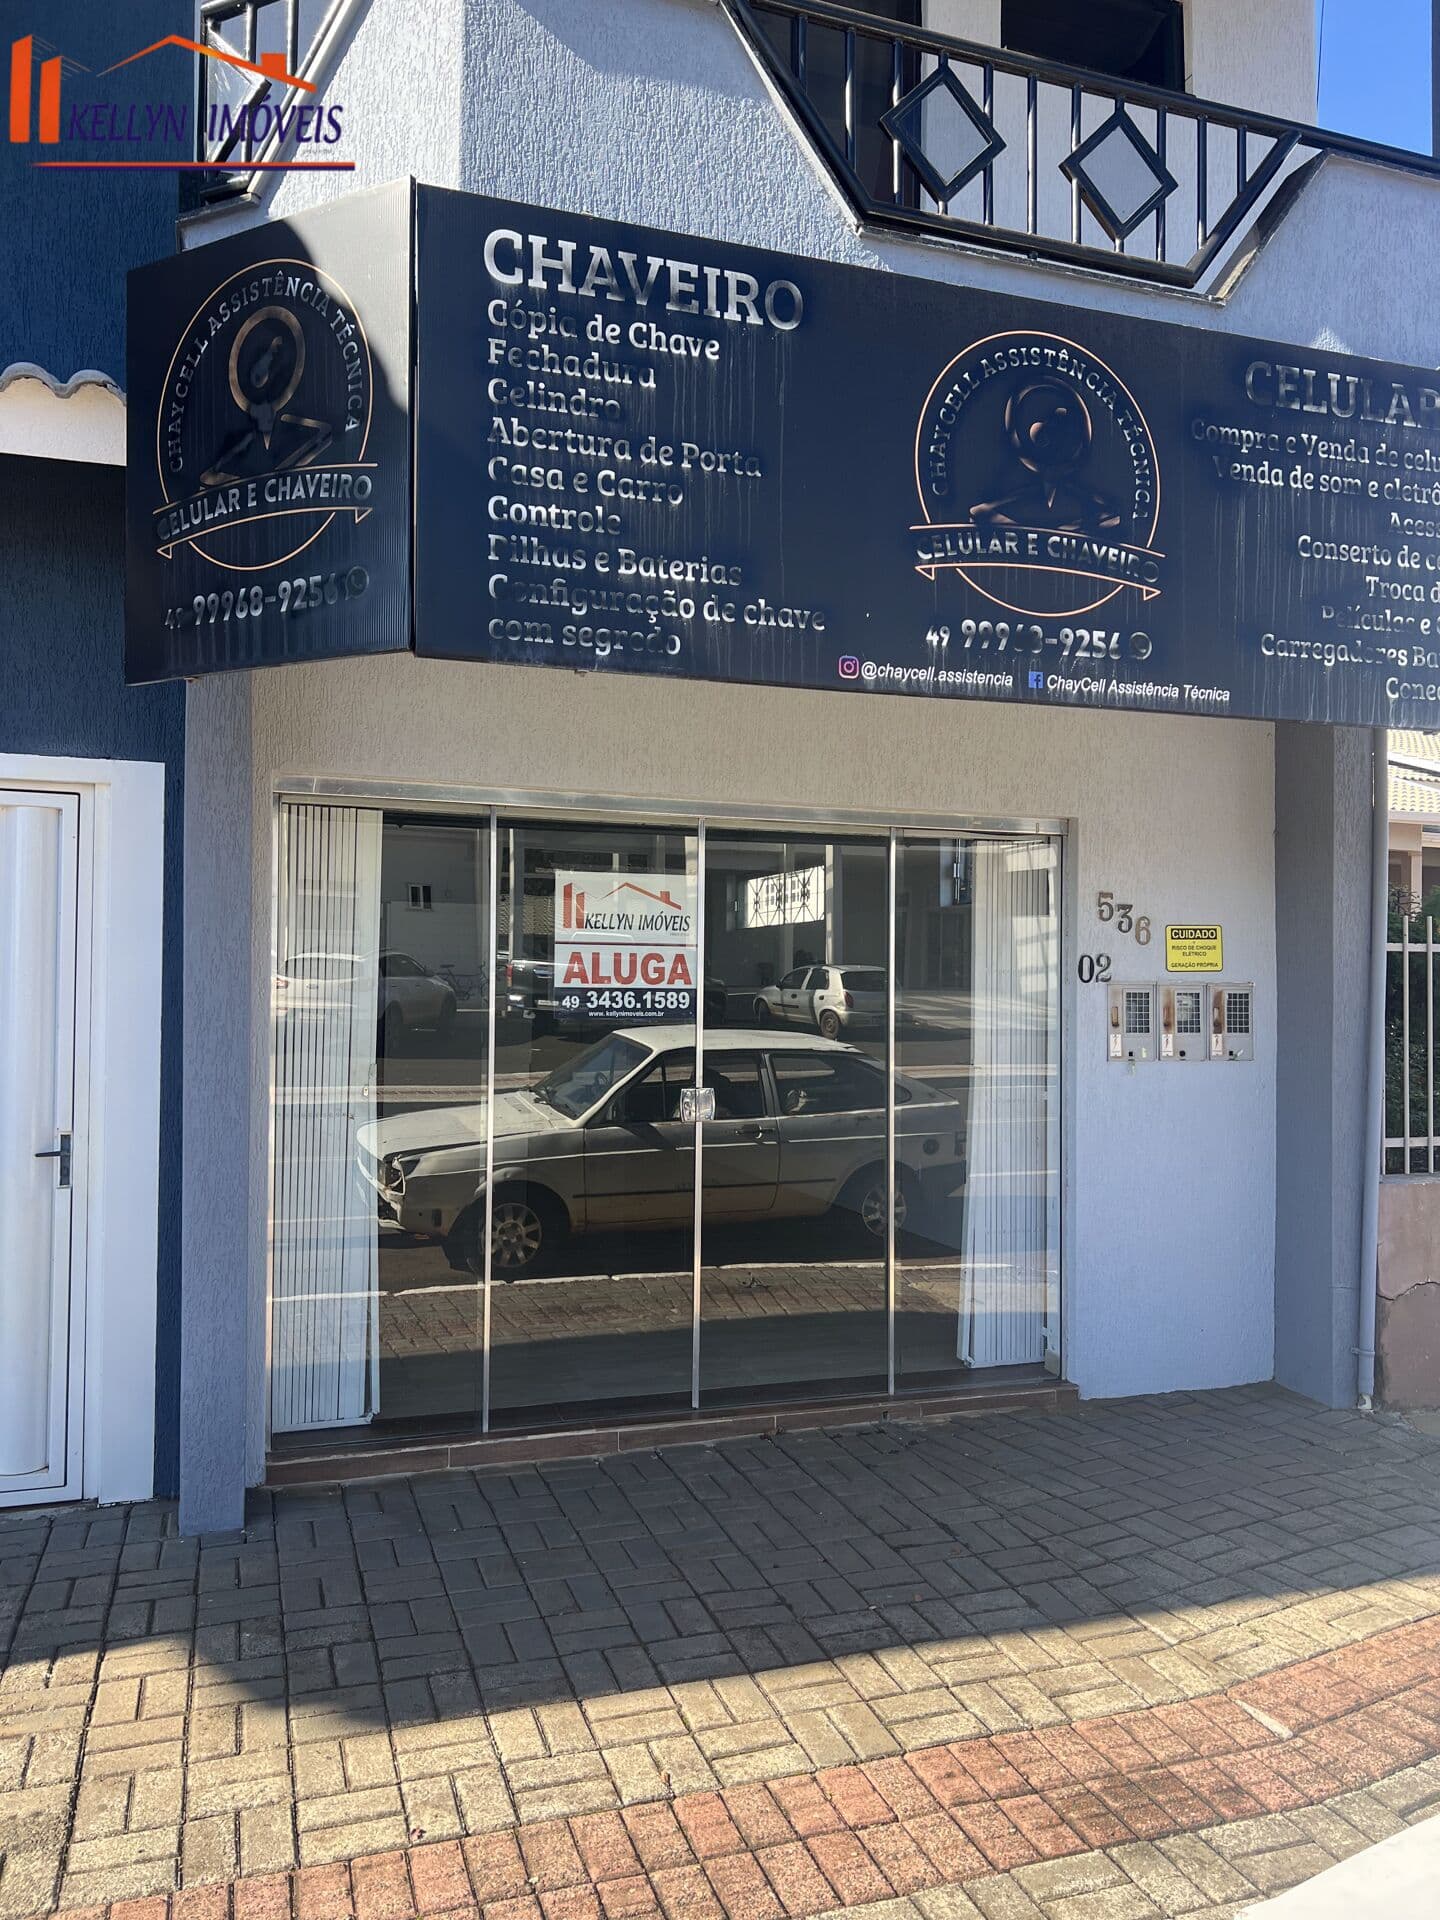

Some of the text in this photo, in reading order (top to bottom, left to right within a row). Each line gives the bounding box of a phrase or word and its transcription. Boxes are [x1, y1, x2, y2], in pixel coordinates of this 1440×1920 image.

[483, 228, 804, 331] CHAVEIRO
[487, 299, 720, 360] Cópia de Chave
[168, 270, 363, 474] CHAYCELL ASSISTÊNCIA TÉCNICA
[487, 337, 657, 388] Fechadura
[980, 347, 1117, 410] ASSISTÊNCIA
[487, 378, 622, 420] Celindro
[487, 416, 763, 478] Abertura de Porta
[1192, 418, 1280, 453] Compra
[1285, 436, 1297, 453] e
[1301, 433, 1370, 464] Venda
[1375, 443, 1398, 467] de
[487, 456, 684, 505] Casa e Carro
[1289, 465, 1314, 490] de
[1319, 474, 1361, 495] som
[1367, 480, 1379, 498] e
[157, 474, 373, 541] CELULAR E CHAVEIRO
[487, 495, 622, 535] Controle
[916, 531, 1019, 560] CELULAR
[1027, 533, 1038, 555] E
[1297, 534, 1392, 566] Conserto
[1397, 545, 1421, 569] de
[594, 550, 610, 573] e
[617, 548, 743, 586] Baterias
[1365, 575, 1427, 603] Troca
[488, 616, 554, 643] com
[703, 594, 736, 623] de
[743, 598, 826, 631] chave
[1420, 618, 1431, 635] e
[925, 625, 950, 647] 49
[861, 661, 1013, 687] @chaycell.assistencia
[1047, 673, 1230, 701] ChayCell Assistência Técnica
[585, 911, 691, 931] KELLYN IMÓVEIS
[1097, 891, 1151, 946] 536
[1172, 929, 1216, 939] CUIDADO
[562, 951, 692, 985] ALUGA
[1078, 953, 1112, 983] 02
[562, 990, 690, 1009] 49 3436.1589
